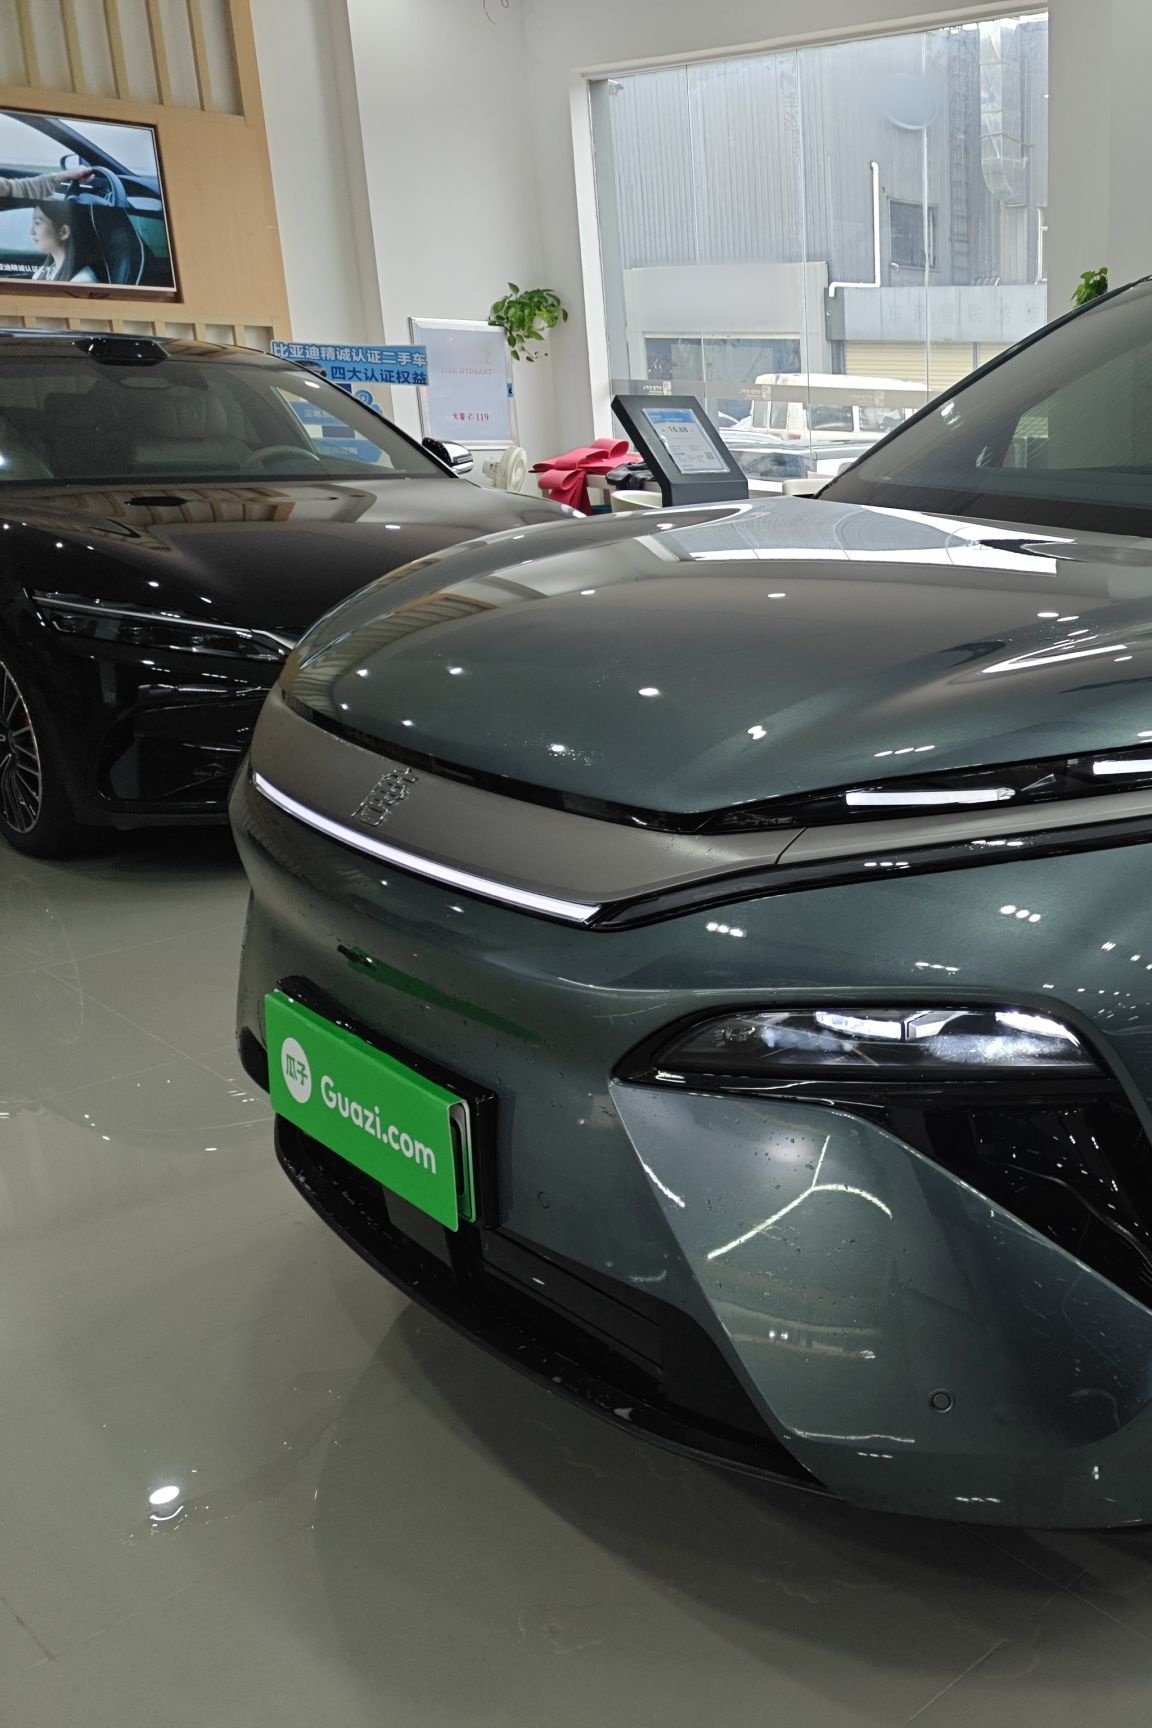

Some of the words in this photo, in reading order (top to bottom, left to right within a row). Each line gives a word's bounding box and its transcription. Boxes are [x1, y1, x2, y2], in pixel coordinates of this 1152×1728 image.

[272, 342, 427, 366] 比亚迪精诚认证二手车
[331, 366, 427, 385] 四大认证权益
[476, 412, 489, 421] 119
[286, 1054, 308, 1088] 瓜子
[320, 1074, 437, 1175] Guazi.com
